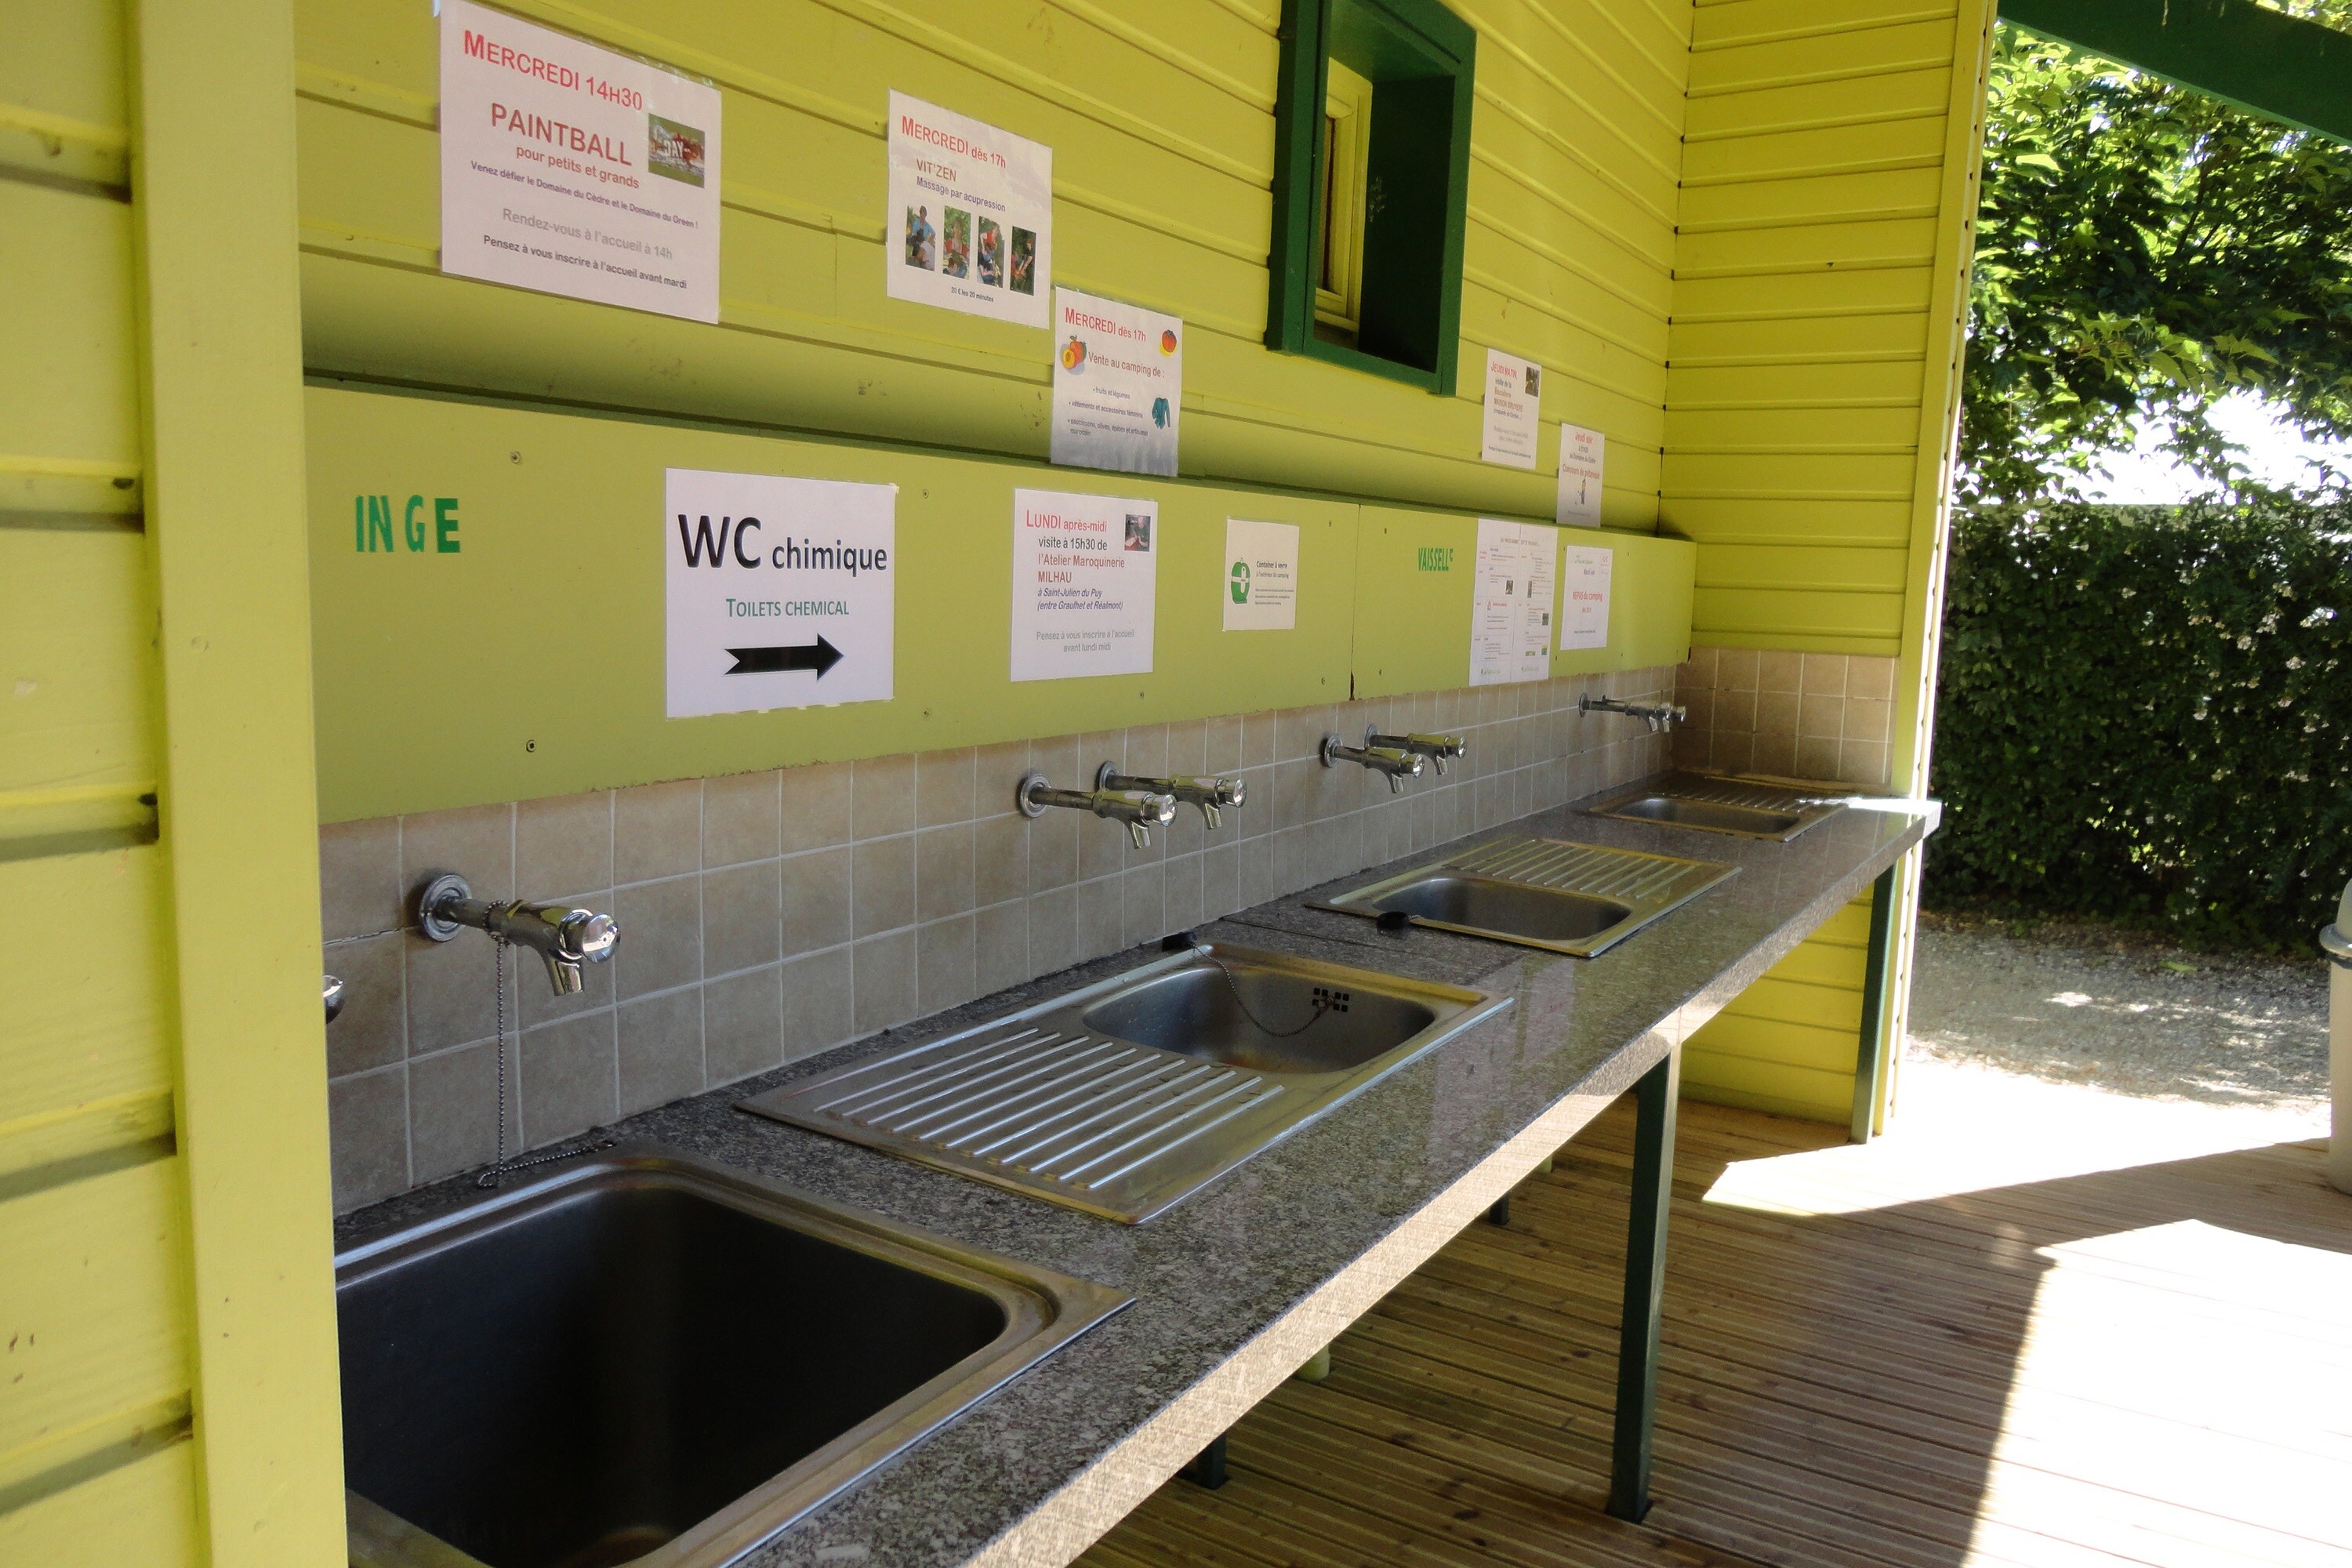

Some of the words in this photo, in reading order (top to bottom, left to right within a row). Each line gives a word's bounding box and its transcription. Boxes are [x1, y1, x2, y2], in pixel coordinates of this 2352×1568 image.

[463, 30, 579, 91] MERCREDI
[586, 77, 643, 111] 14H30
[491, 103, 632, 166] PAINTBALL
[902, 115, 969, 155] MERCREDI
[971, 146, 988, 162] dès
[990, 152, 1006, 169] 17h
[516, 145, 544, 162] pour
[548, 153, 581, 173] petits
[585, 163, 597, 178] et
[599, 167, 640, 189] grands
[471, 160, 498, 177] Venez
[500, 167, 525, 183] défier
[527, 174, 534, 186] le
[536, 178, 572, 197] Domaine
[574, 187, 584, 199] du
[586, 191, 610, 207] Cèdre
[612, 197, 619, 209] et
[621, 199, 627, 211] le
[630, 203, 661, 220] Domaine
[662, 211, 672, 223] du
[673, 213, 692, 228] Green
[916, 176, 949, 196] Massage
[950, 188, 963, 200] par
[964, 193, 1006, 212] acupression
[503, 208, 581, 239] Rendez-vous
[585, 227, 591, 241] à
[594, 230, 642, 252] l'accueil
[644, 241, 652, 255] à
[654, 245, 673, 260] 14h
[483, 234, 520, 252] Pensez
[522, 242, 528, 253] à
[530, 246, 553, 260] vous
[555, 249, 591, 268] inscrire
[593, 257, 599, 270] à
[601, 260, 637, 278] l'accueil
[639, 269, 662, 284] avant
[664, 274, 687, 289] mardi
[976, 292, 994, 303] minutes
[1065, 307, 1116, 336] MERCREDI
[1118, 325, 1132, 339] dès
[1134, 329, 1146, 342] 17h
[1088, 351, 1109, 367] Vente
[1111, 358, 1120, 368] au
[1122, 361, 1151, 377] camping
[1152, 366, 1161, 377] de
[1095, 387, 1107, 396] fruits
[1112, 390, 1131, 400] légumes
[1072, 400, 1094, 410] vêtements
[1095, 403, 1100, 412] et
[1101, 405, 1126, 416] accessoires
[1026, 510, 1061, 529] LUNDI
[1064, 520, 1107, 533] après-midi
[677, 514, 761, 569] WC
[772, 536, 887, 578] chimique
[1038, 535, 1061, 548] visite
[1063, 537, 1068, 549] à
[1071, 539, 1095, 550] 15h30
[1098, 539, 1107, 550] de
[1038, 554, 1071, 567] l'Atelier
[1073, 555, 1125, 569] Maroquinerie
[1038, 572, 1072, 583] MILHAU
[1038, 588, 1042, 597] à
[1043, 588, 1080, 597] Saint-Julien
[1081, 588, 1090, 597] du
[1091, 589, 1102, 600] Puy
[725, 598, 781, 617] TOILETS
[786, 601, 849, 616] CHEMICAL
[1037, 601, 1056, 611] (entre
[1058, 601, 1085, 610] Graulhet
[1094, 601, 1123, 611] Réalmont)
[1036, 631, 1059, 641] Pensez
[1061, 631, 1065, 640] à
[1083, 630, 1105, 639] inscrire
[1112, 630, 1134, 638] l'accueil
[1064, 644, 1081, 652] avant
[1082, 643, 1097, 652] lundi
[1098, 642, 1111, 652] midi
